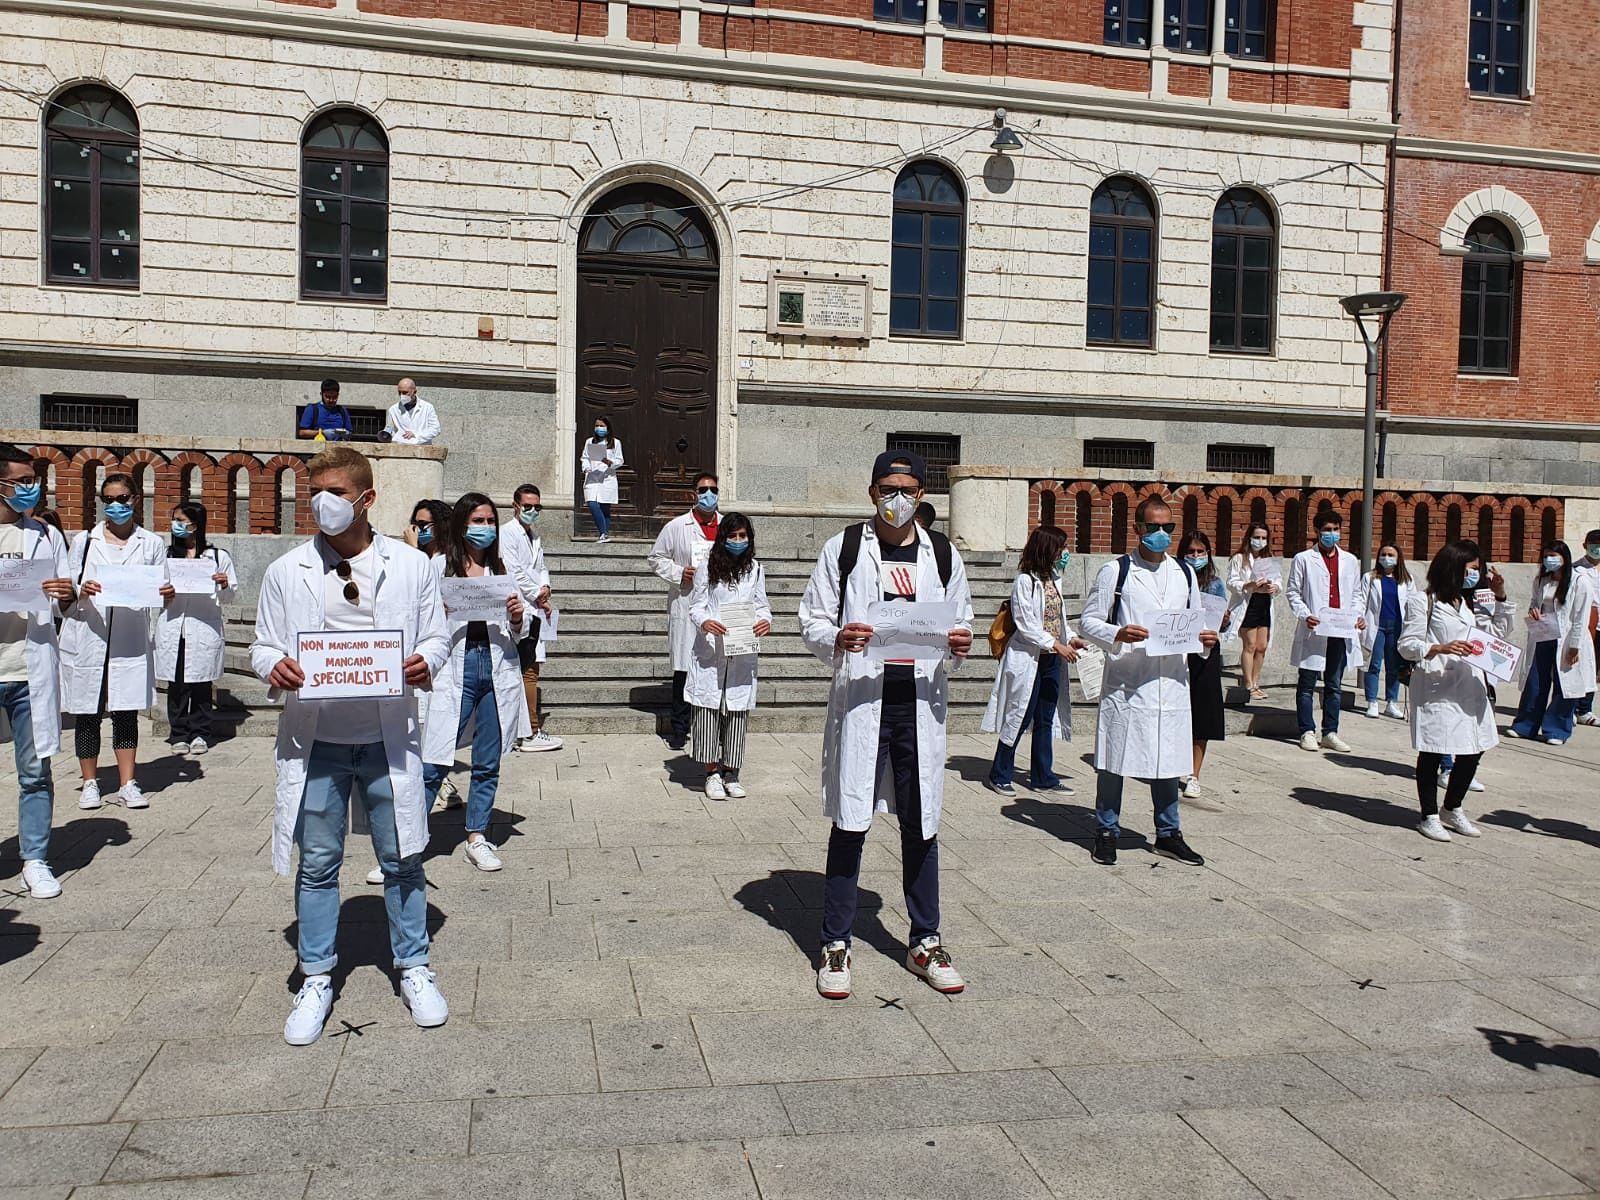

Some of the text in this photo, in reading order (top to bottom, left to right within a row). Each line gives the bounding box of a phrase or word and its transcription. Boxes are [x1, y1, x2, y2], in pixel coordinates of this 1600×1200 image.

[880, 607, 908, 617] STOP
[1156, 612, 1198, 631] STOP
[301, 640, 400, 652] NON MANCANO MEDICI
[326, 656, 374, 667] MANCANO
[310, 670, 388, 687] SPECIALISTI
